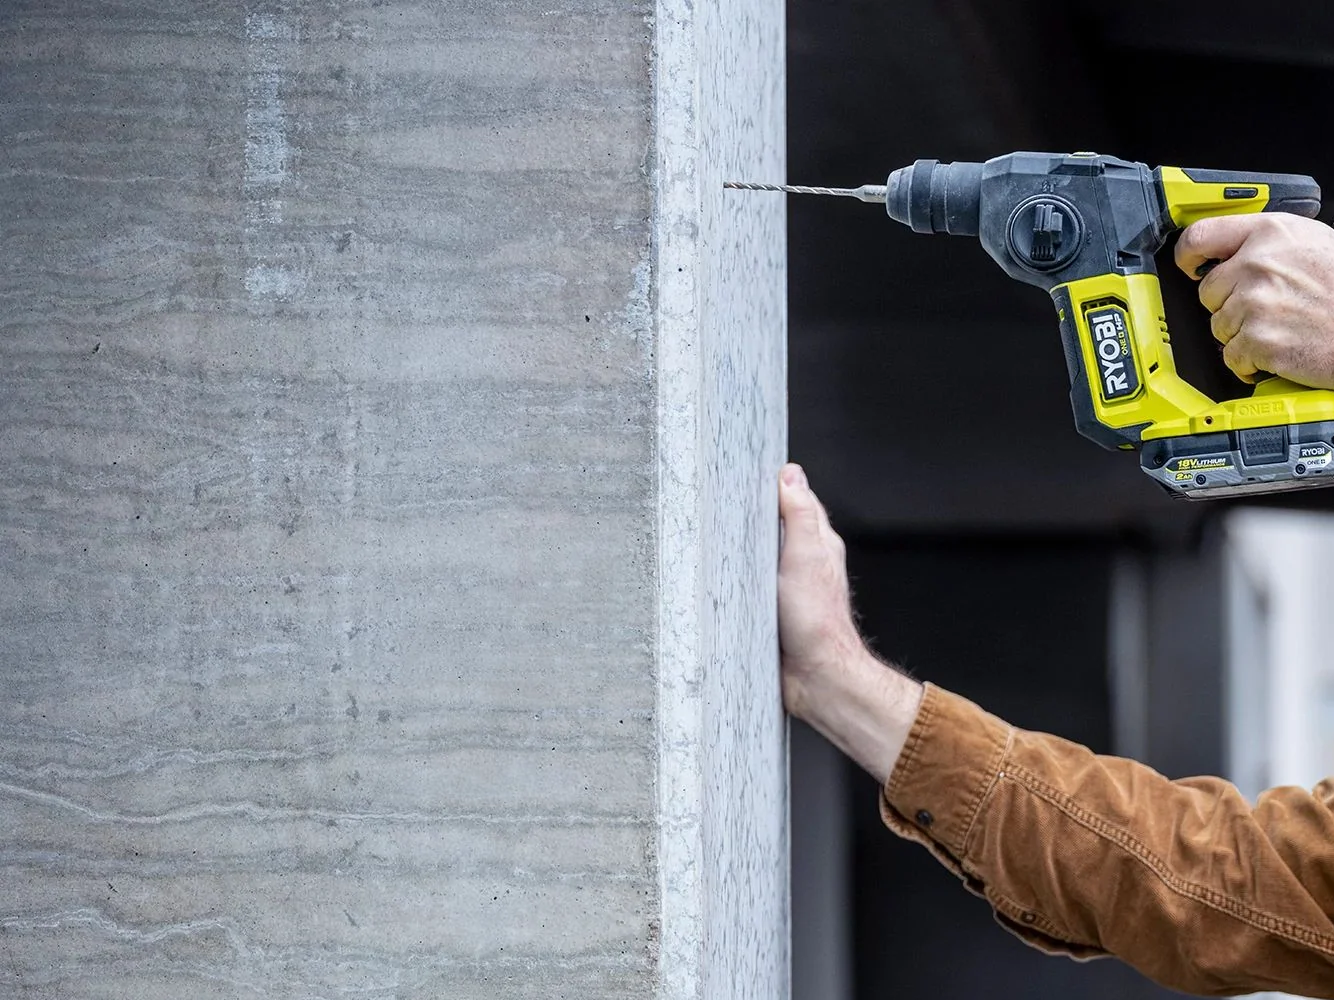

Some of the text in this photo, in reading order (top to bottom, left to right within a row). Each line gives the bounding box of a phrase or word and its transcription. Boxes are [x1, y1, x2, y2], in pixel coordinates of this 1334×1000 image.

[1113, 313, 1123, 331] HP
[1092, 314, 1129, 394] RYOBI
[1301, 447, 1325, 457] RYOBI
[1177, 457, 1226, 467] 18V LITHIUM
